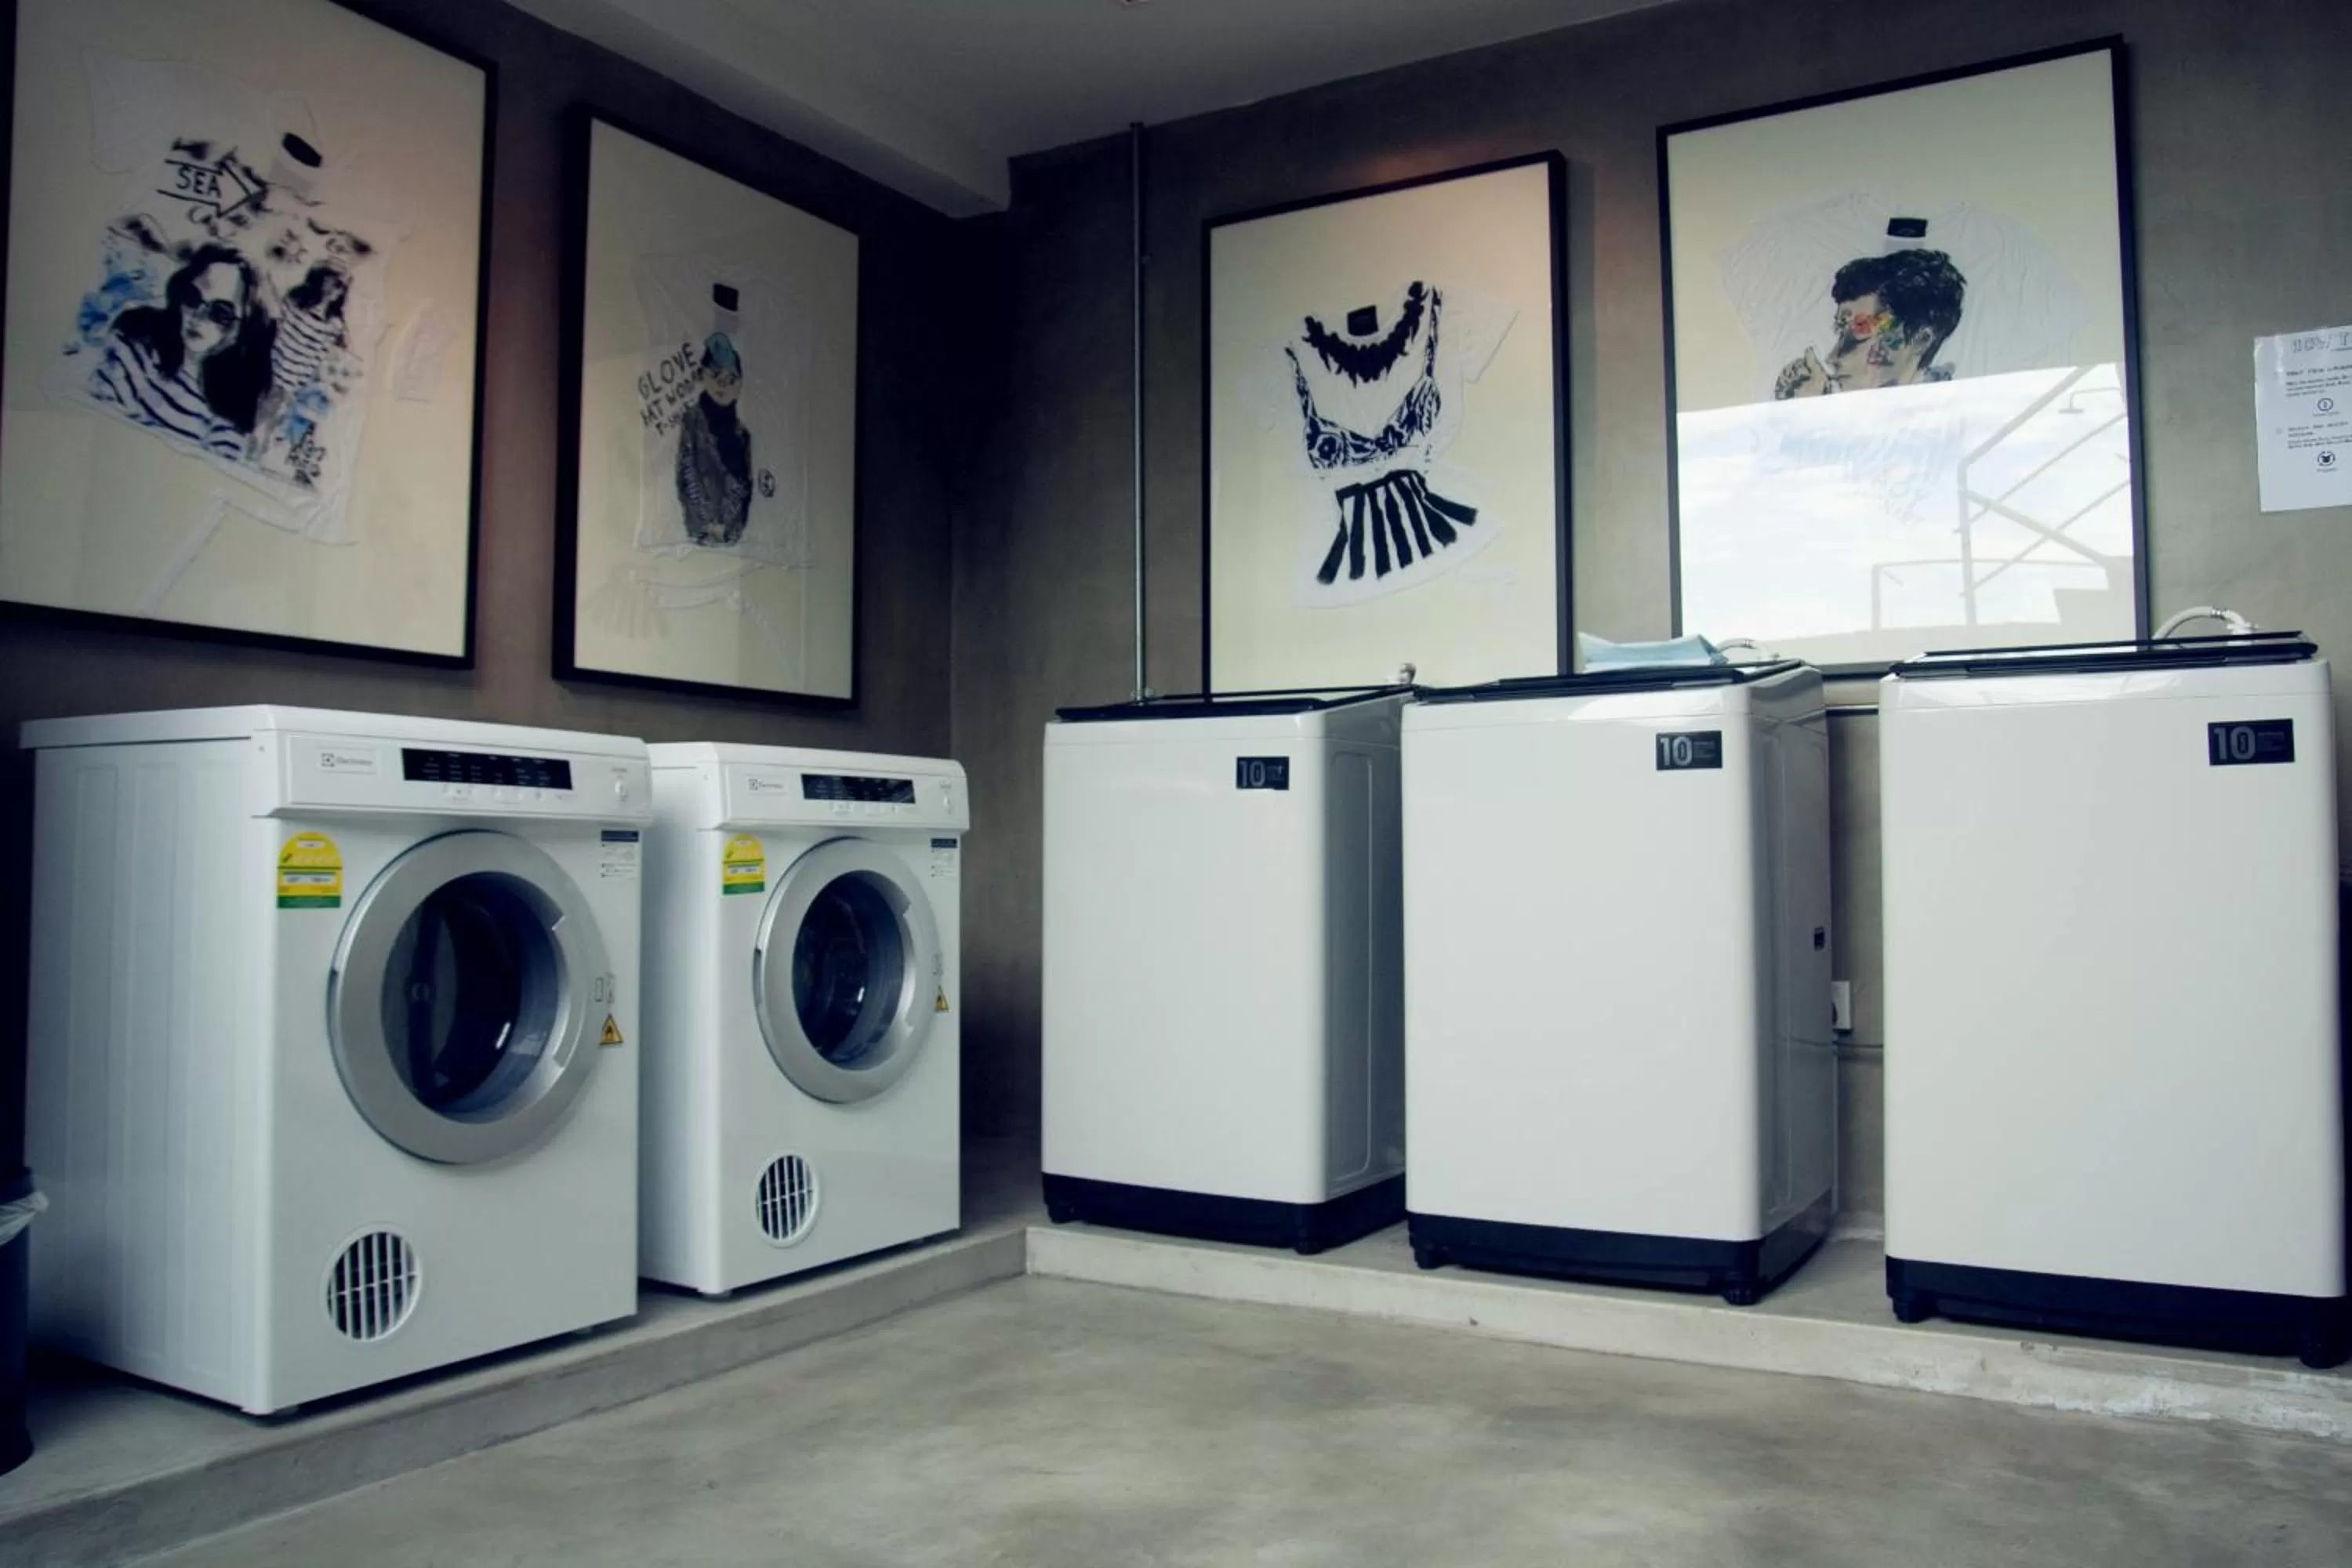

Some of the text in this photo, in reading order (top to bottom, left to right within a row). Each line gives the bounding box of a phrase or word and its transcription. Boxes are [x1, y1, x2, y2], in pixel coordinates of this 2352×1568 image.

[176, 165, 222, 199] SEA
[1660, 736, 1693, 767] 10
[2214, 726, 2256, 760] 10
[1239, 760, 1266, 788] 10
